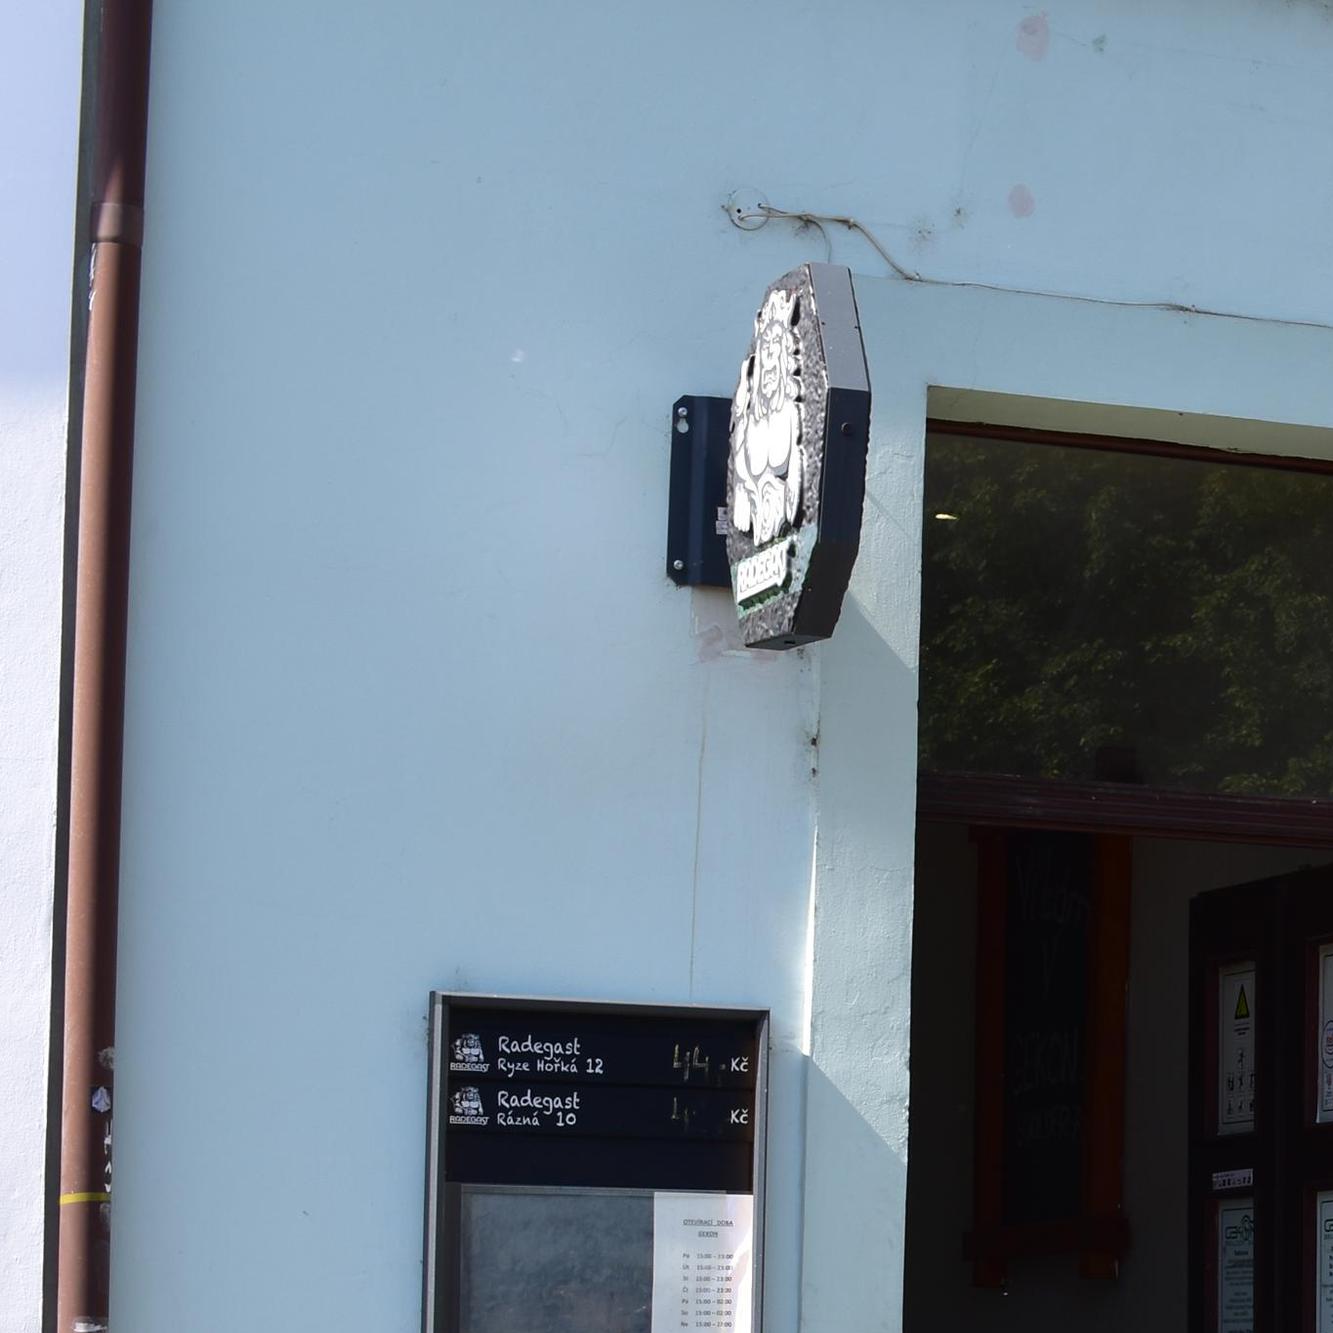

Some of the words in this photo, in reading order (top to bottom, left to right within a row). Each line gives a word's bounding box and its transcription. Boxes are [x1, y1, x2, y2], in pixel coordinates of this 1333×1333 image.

[737, 541, 788, 602] RADEGAST
[499, 1035, 581, 1059] Radegast
[498, 1058, 530, 1077] Ryze
[537, 1057, 578, 1073] Hořká
[586, 1058, 604, 1074] 12
[730, 1056, 749, 1072] Kč
[498, 1089, 581, 1114] Radegast
[497, 1111, 540, 1126] Rázná
[556, 1112, 577, 1126] 10
[730, 1108, 749, 1124] Kč
